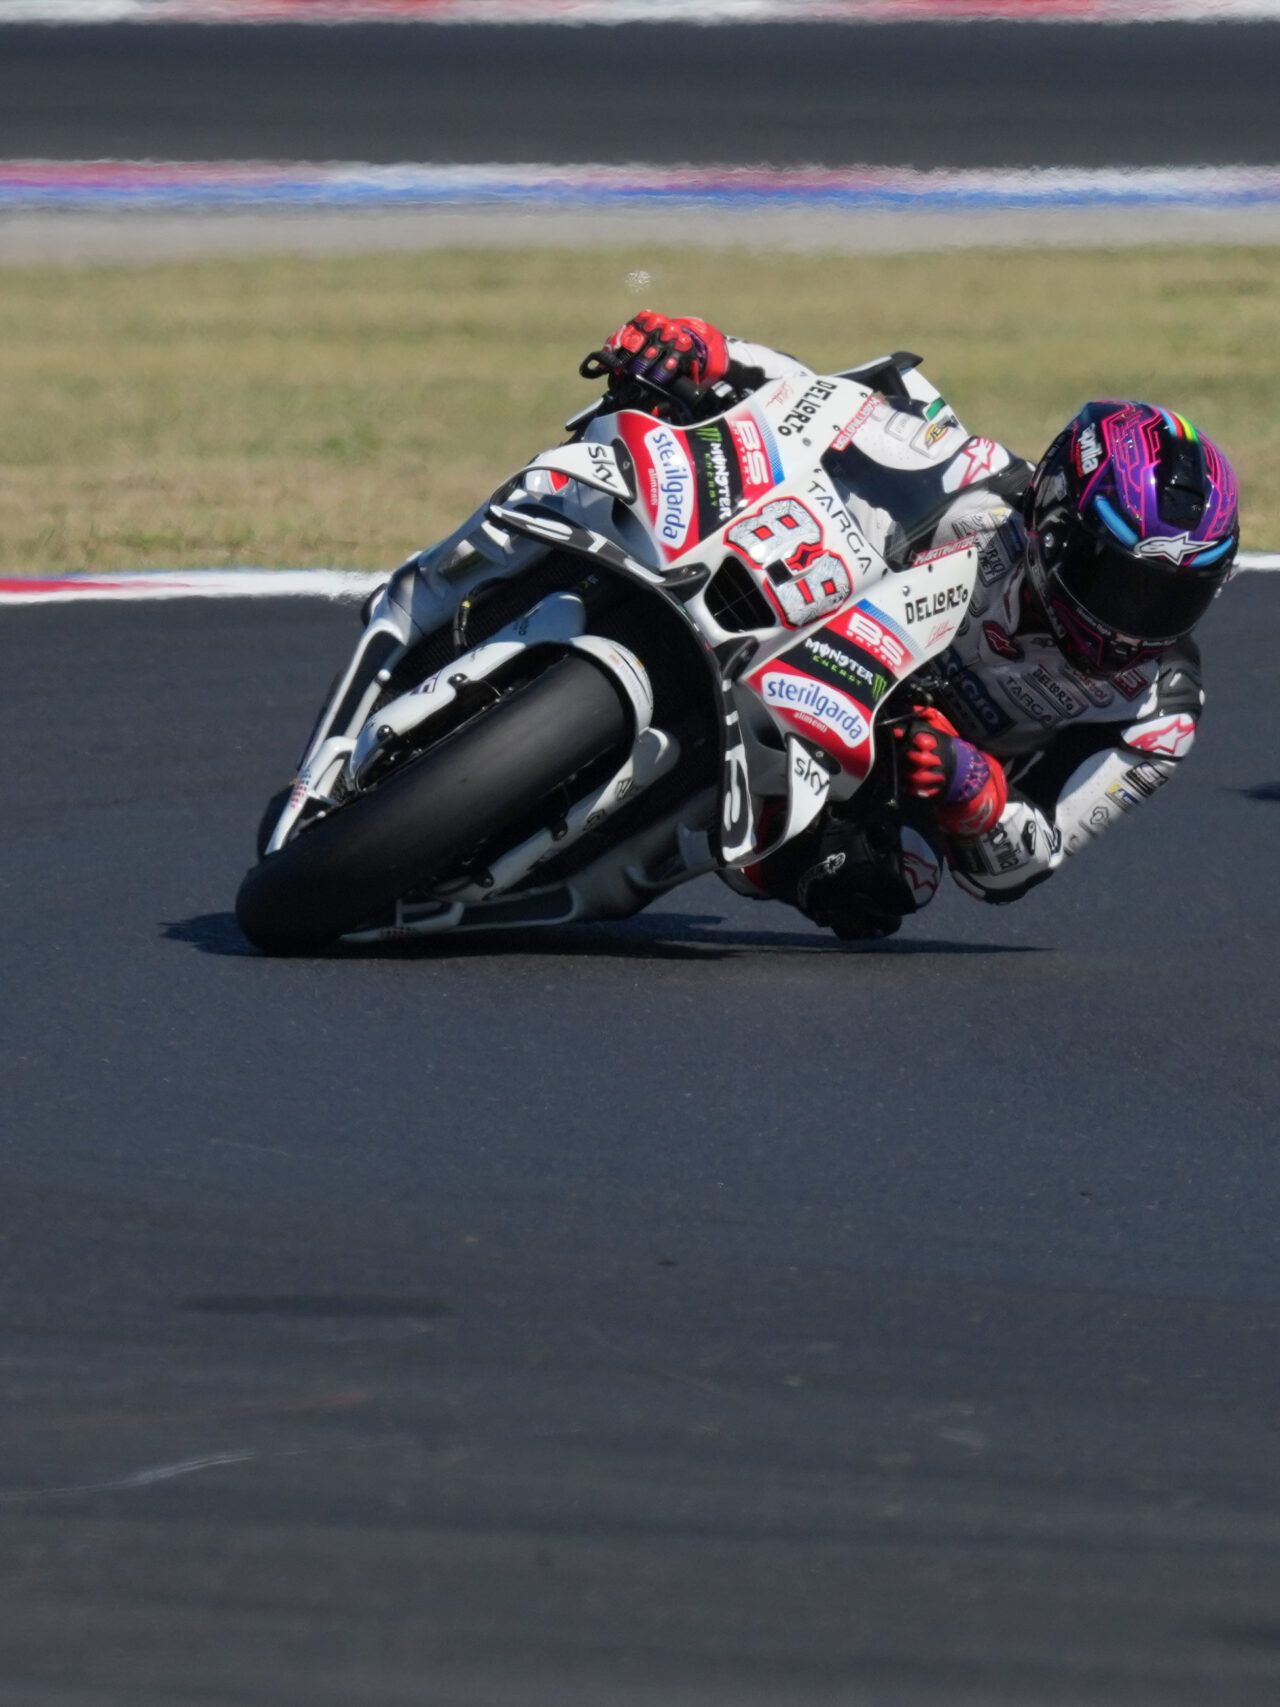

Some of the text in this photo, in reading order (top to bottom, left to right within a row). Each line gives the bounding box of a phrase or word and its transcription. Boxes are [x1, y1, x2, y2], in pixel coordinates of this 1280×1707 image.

[652, 432, 689, 540] sterilgarda
[710, 443, 732, 519] MONSTER
[808, 481, 872, 576] TARGA
[805, 637, 873, 685] MONSTER
[850, 613, 902, 665] BS
[813, 656, 862, 686] ENERGY
[767, 678, 862, 740] sterilgarda
